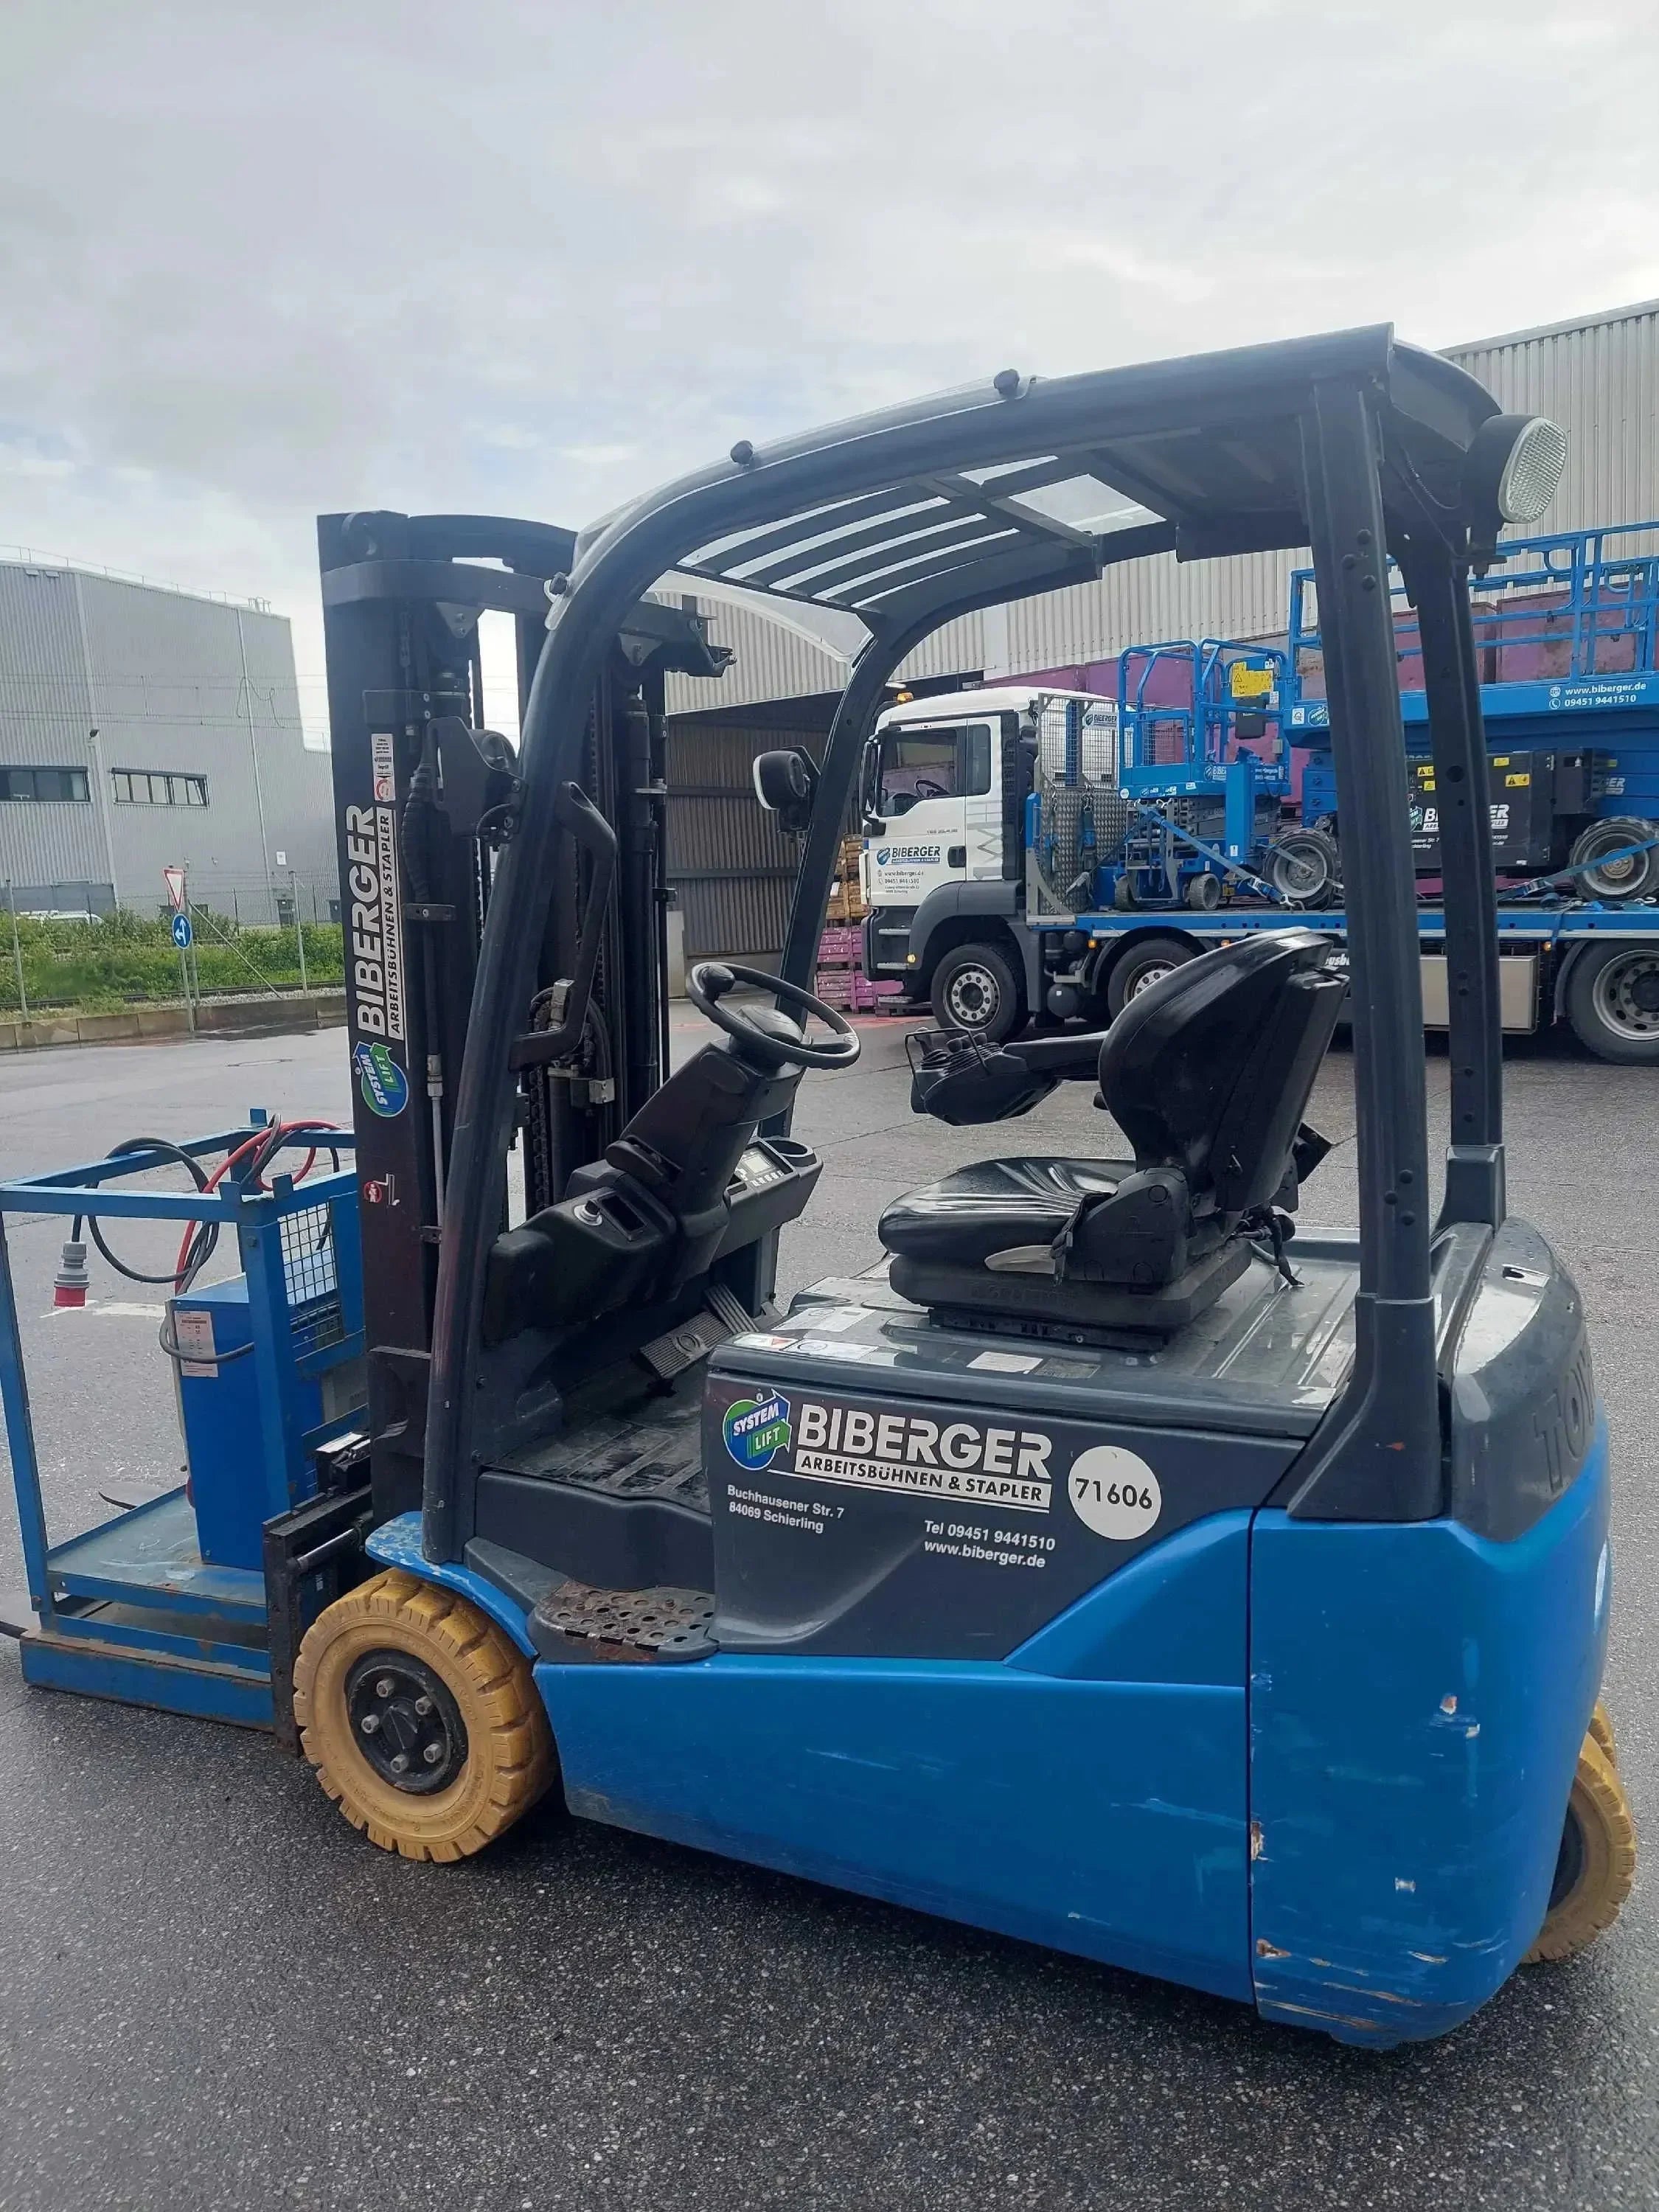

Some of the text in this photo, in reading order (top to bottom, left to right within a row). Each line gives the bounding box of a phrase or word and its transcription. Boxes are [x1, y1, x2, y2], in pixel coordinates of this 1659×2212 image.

[1564, 695, 1637, 707] 09451 9441510
[1565, 682, 1646, 695] www.biberger.de
[891, 846, 941, 858] BIBERGER
[347, 805, 386, 1036] BIBERGER
[380, 815, 400, 1034] ARBEITSBÜHNEN & STAPLER
[360, 1054, 389, 1106] SYSTEM
[375, 1054, 394, 1083] LIFT
[733, 1402, 779, 1436] SYSTEM
[755, 1426, 780, 1450] LIFT
[797, 1403, 1052, 1480] BIBERGER
[801, 1455, 1043, 1501] ARBEITSBÜHNEN & STAPLER
[1075, 1477, 1152, 1510] 71606
[727, 1484, 844, 1519] Buchhausener Str. 7
[728, 1501, 824, 1534] 84069 Schierling
[924, 1520, 1056, 1551] Tel 09451 9441510
[924, 1540, 1046, 1568] www.biberger.de
